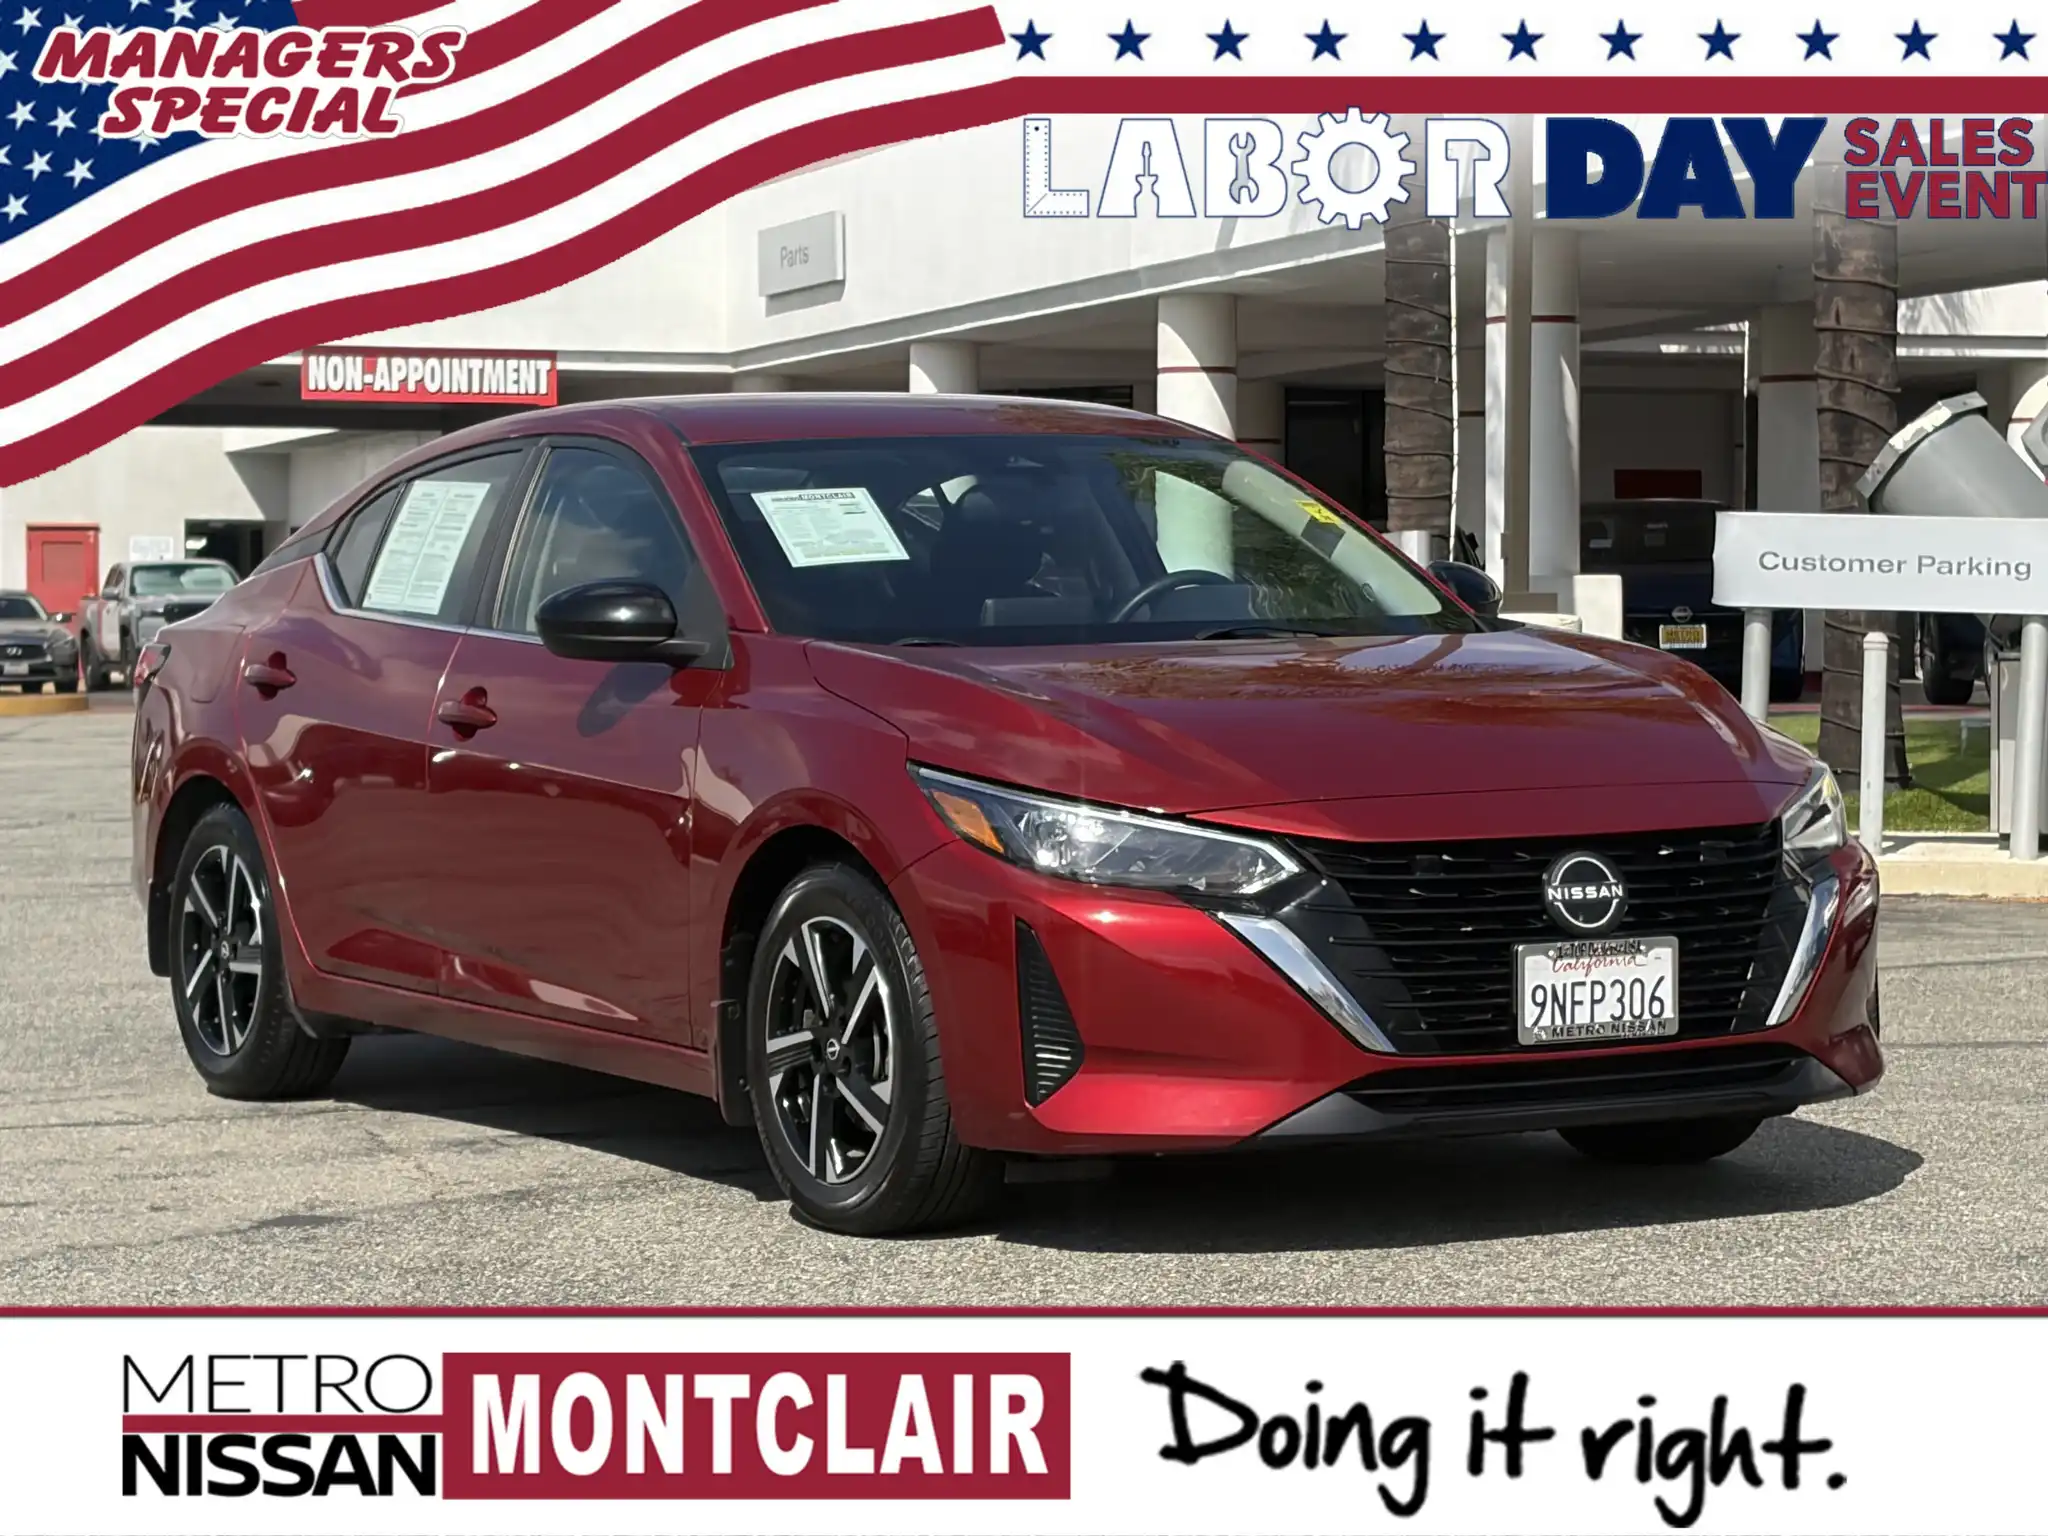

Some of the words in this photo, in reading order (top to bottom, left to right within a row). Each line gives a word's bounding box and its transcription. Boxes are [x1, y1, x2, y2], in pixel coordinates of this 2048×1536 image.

[780, 244, 810, 269] Parts
[308, 355, 551, 396] NON-APPOINTMENT
[1758, 551, 1907, 574] Customer
[1917, 555, 2032, 581] Parking
[1548, 885, 1623, 900] NISSAN
[1531, 975, 1665, 1028] 9NFP306
[1552, 1024, 1606, 1038] METRO
[1611, 1020, 1666, 1034] NISSAN
